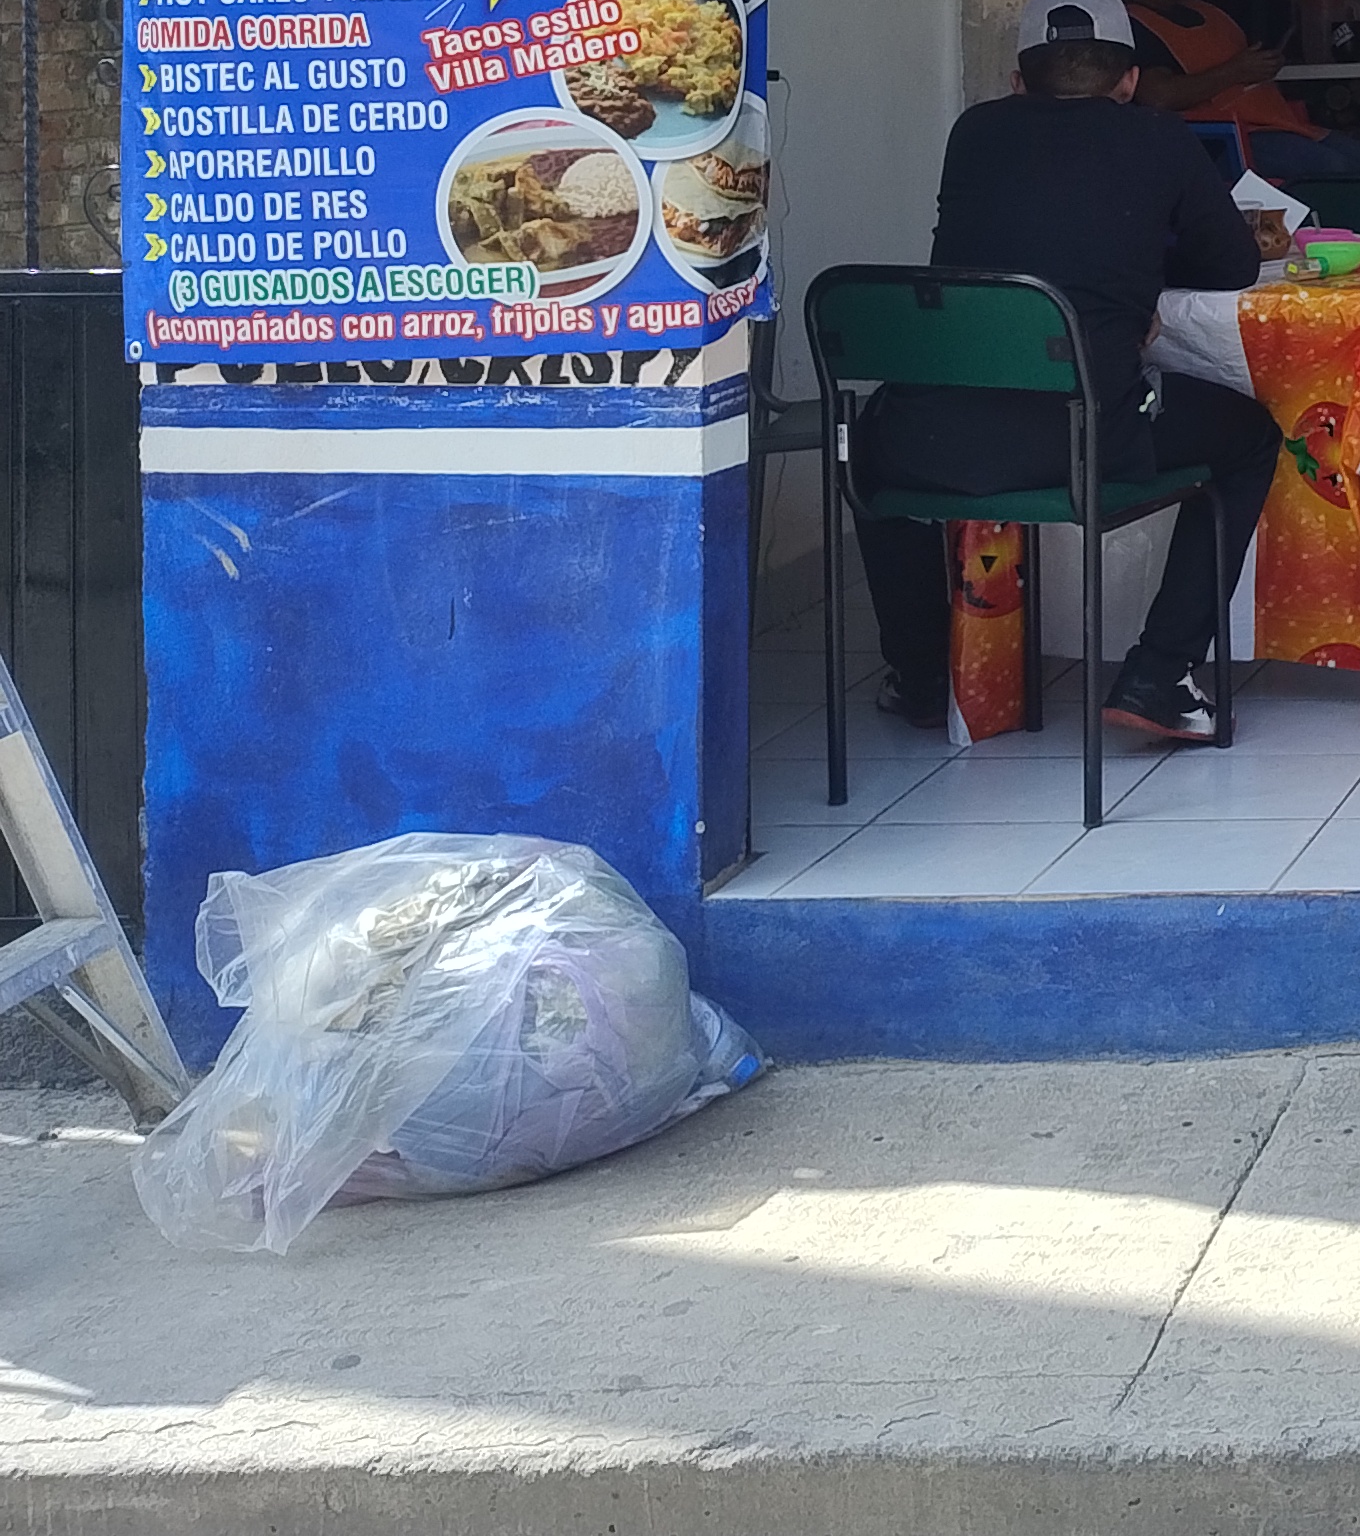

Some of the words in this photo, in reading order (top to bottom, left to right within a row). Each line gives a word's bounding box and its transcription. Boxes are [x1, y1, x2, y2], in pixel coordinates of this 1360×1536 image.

[137, 15, 234, 52] COMIDA
[237, 12, 371, 50] CORRIDA
[422, 18, 523, 60] Tacos
[160, 60, 254, 93] BISTEC
[263, 60, 300, 92] AL
[308, 57, 406, 90] GUSTO
[426, 55, 509, 94] Villa
[510, 28, 641, 77] Madero
[162, 104, 295, 137] COSTILLA
[302, 103, 340, 133] DE
[349, 100, 449, 132] CERDO
[169, 145, 376, 180] APORREADILLO
[170, 192, 254, 223] CALDO
[263, 192, 303, 221] DE
[311, 189, 368, 220] RES
[170, 231, 257, 263] CALDO
[266, 231, 304, 261] DE
[313, 228, 407, 260] POLLO
[169, 270, 199, 312] (3
[202, 268, 352, 307] GUISADOS
[356, 266, 383, 302] A
[387, 261, 540, 302] ESCOGER)
[147, 309, 335, 350] (acompañados
[341, 312, 395, 341] con
[402, 310, 485, 342] arroz,
[490, 302, 595, 342] frijoles
[598, 303, 620, 337] y
[627, 300, 703, 336] agua
